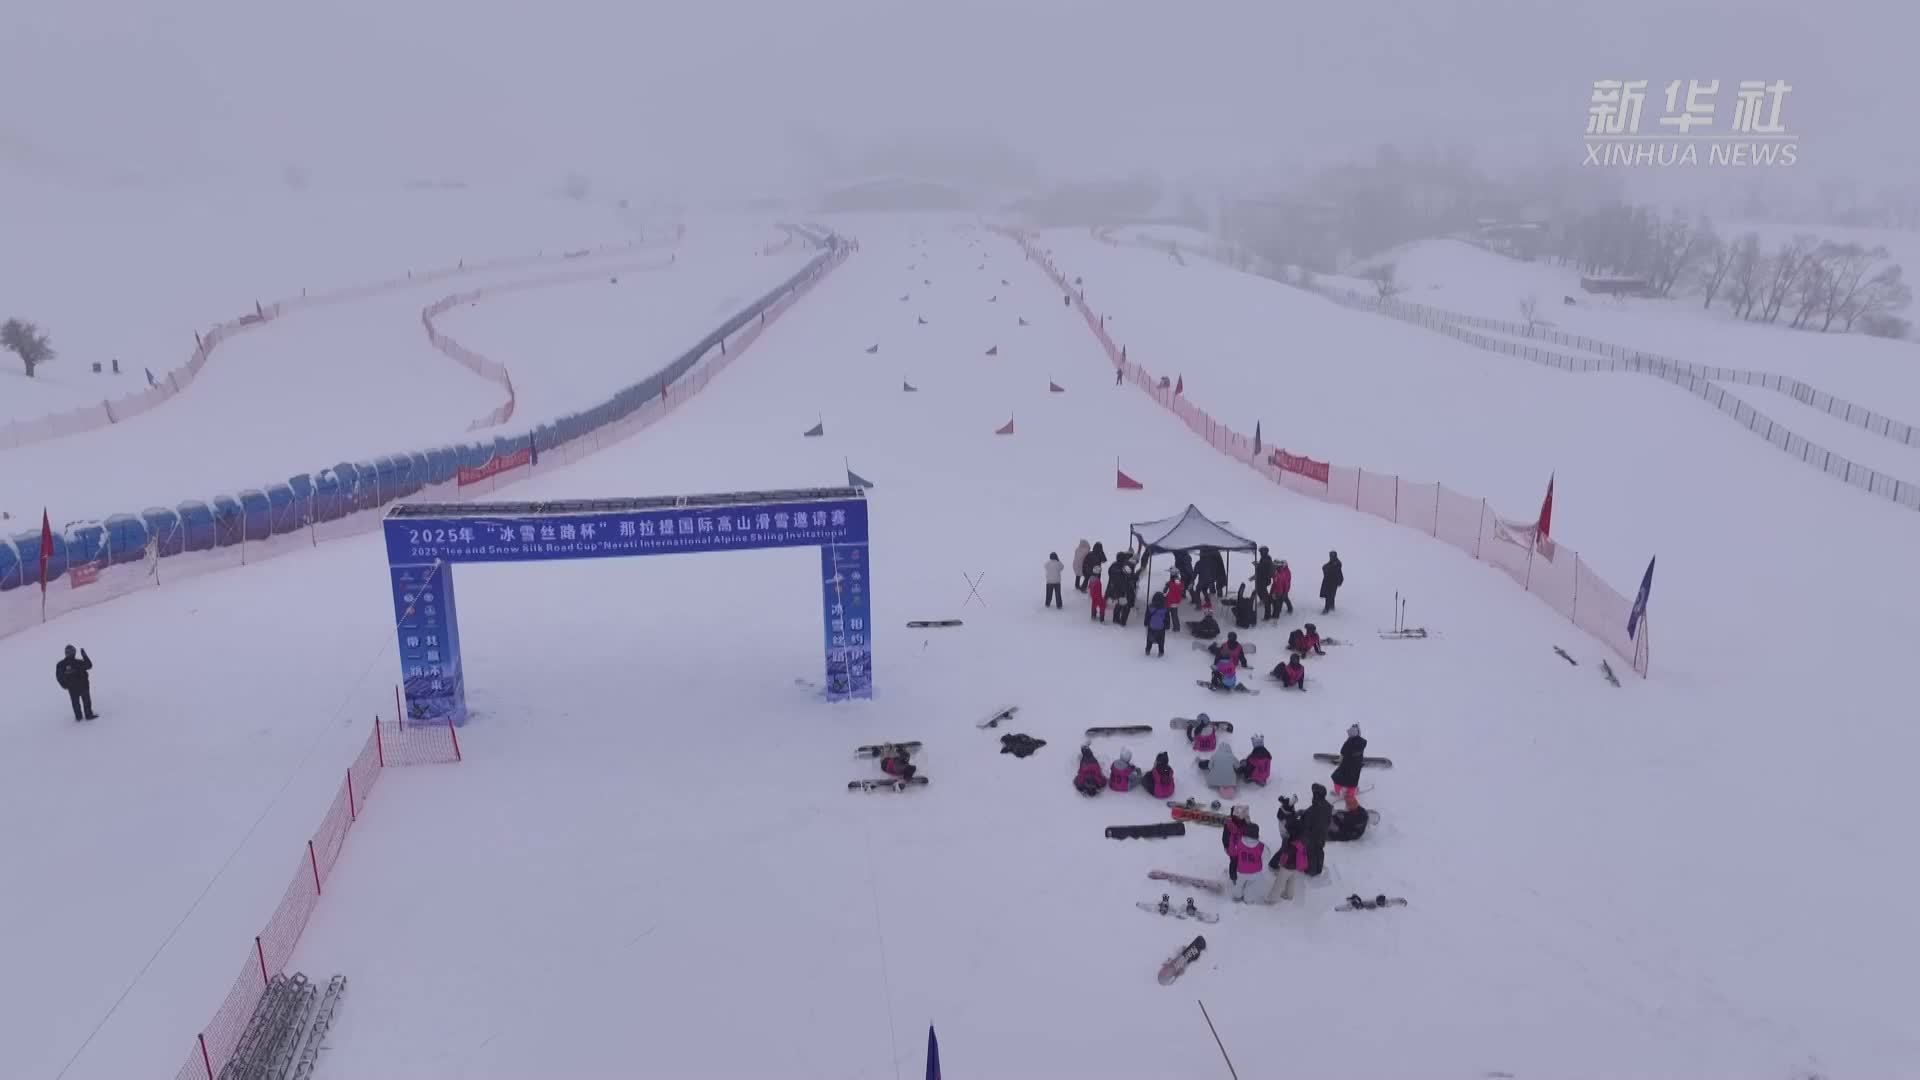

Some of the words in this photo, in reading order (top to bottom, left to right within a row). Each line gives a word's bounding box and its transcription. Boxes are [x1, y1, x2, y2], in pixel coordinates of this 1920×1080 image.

[411, 547, 438, 556] 2025
[465, 545, 485, 554] and
[488, 545, 519, 554] Snow
[522, 543, 543, 552] Silk
[546, 543, 574, 552] Road
[640, 535, 711, 548] International
[714, 535, 748, 545] Alpine
[751, 532, 784, 542] Skiing
[786, 527, 847, 539] Invitational
